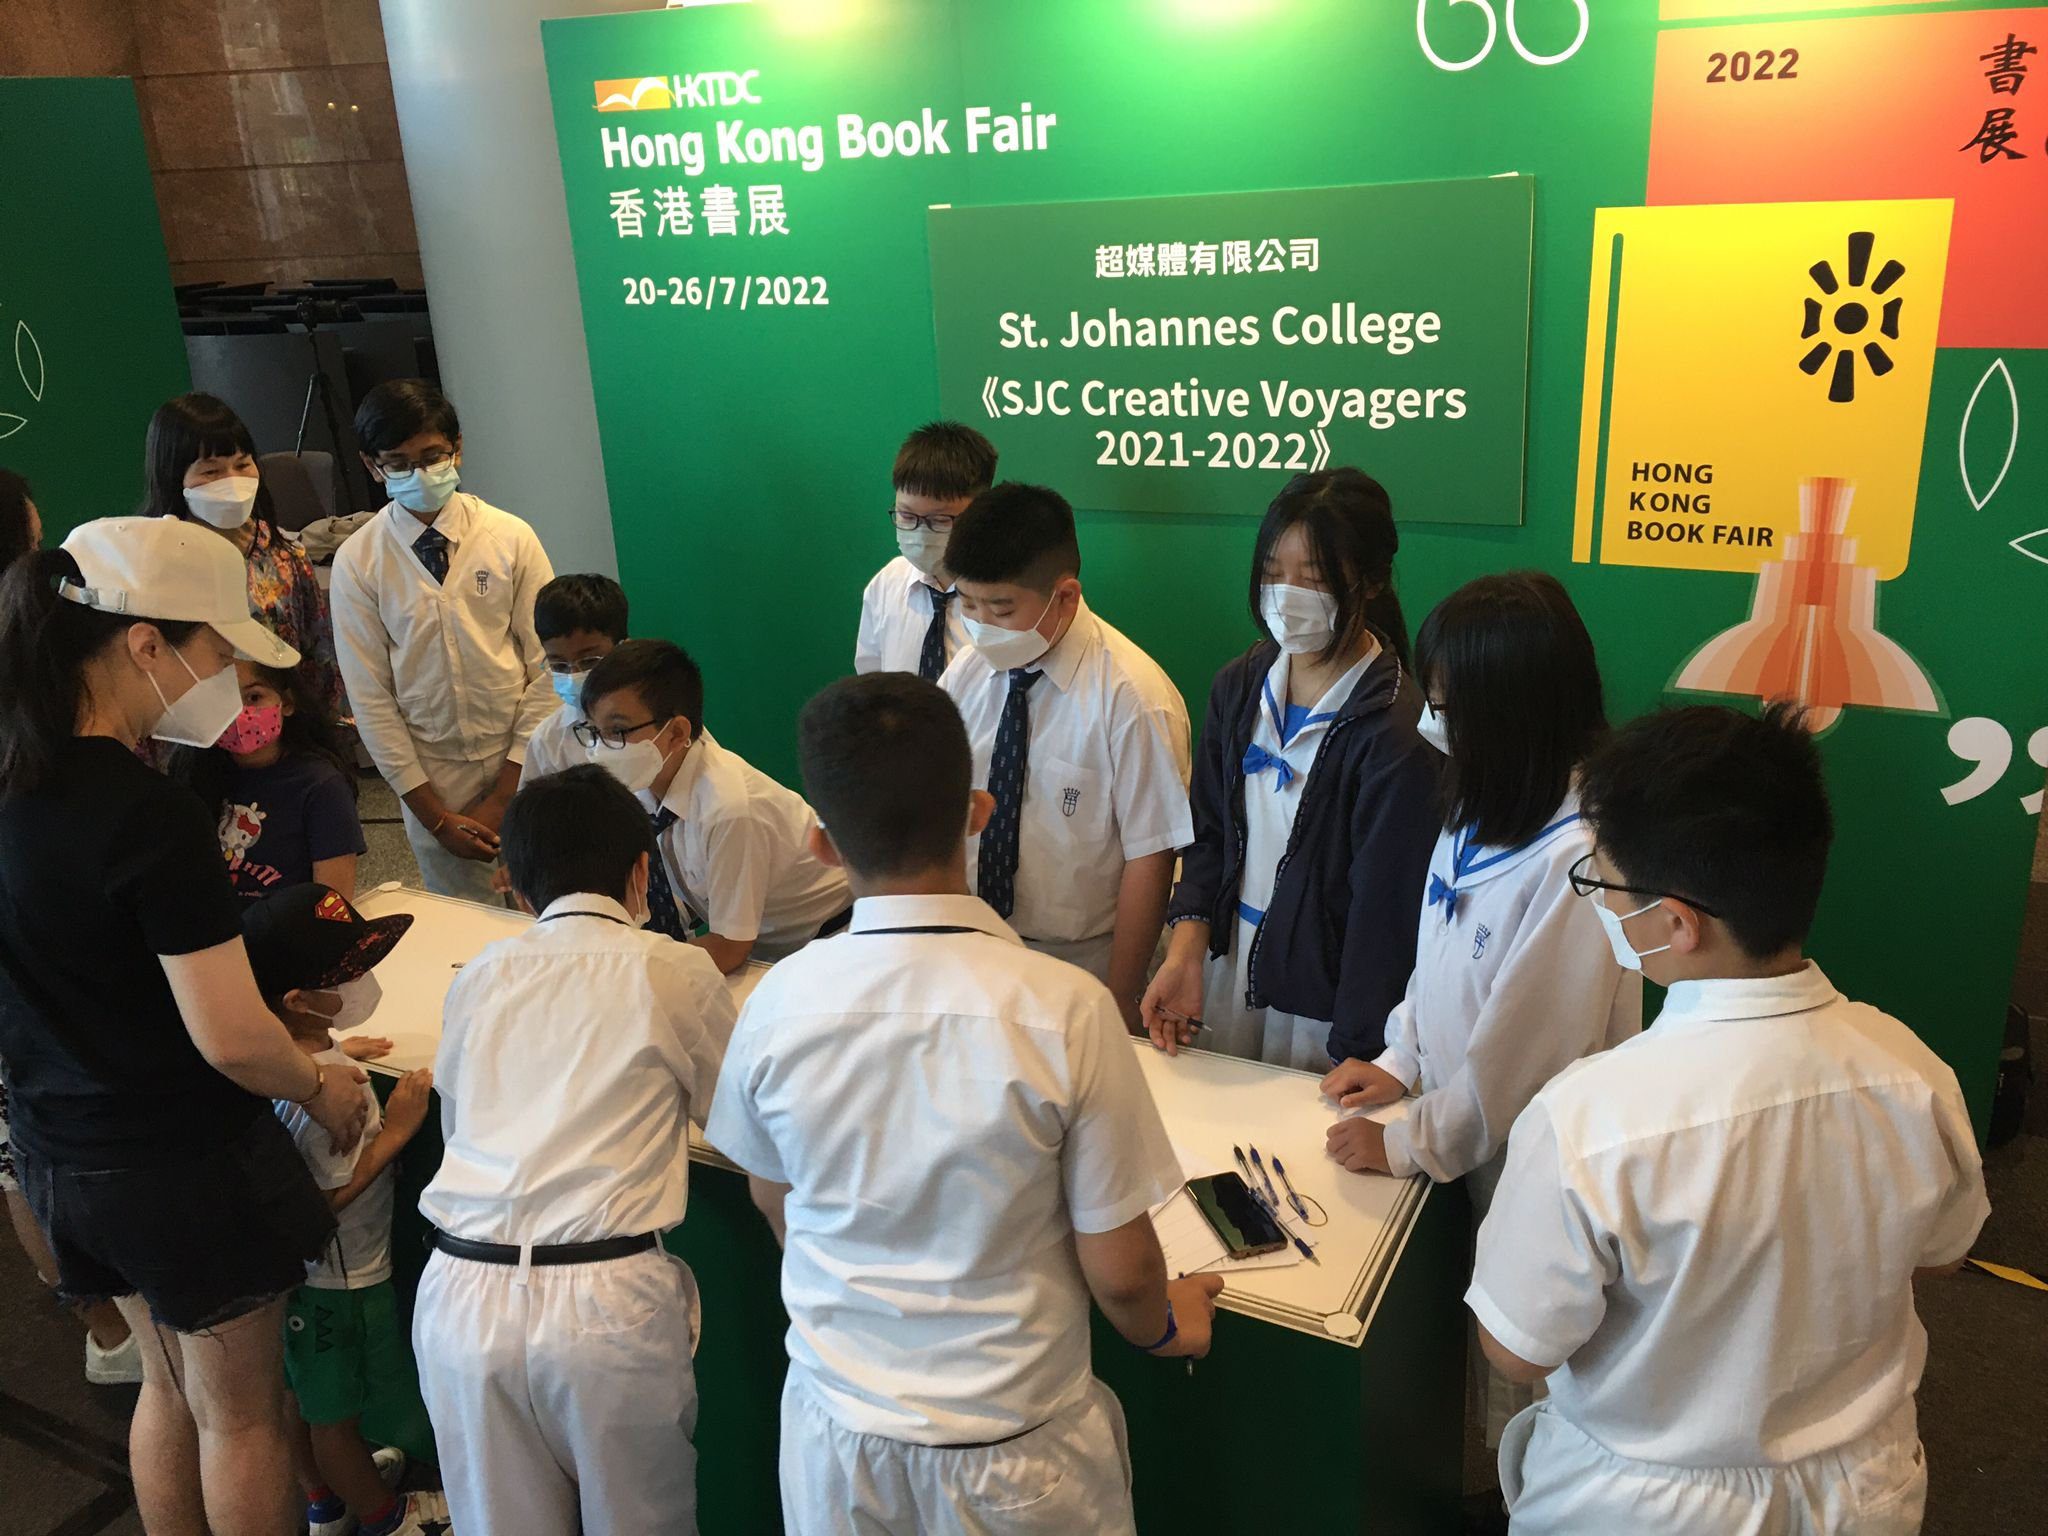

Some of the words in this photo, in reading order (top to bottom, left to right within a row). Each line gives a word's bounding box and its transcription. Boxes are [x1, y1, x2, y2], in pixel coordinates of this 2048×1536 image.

[1706, 48, 1800, 84] 2022
[673, 69, 762, 108] HKTDC
[1959, 33, 2038, 165] 書展
[600, 126, 706, 177] Hong
[715, 119, 825, 172] Kong
[836, 107, 951, 159] Book
[965, 101, 1057, 153] Fair
[609, 183, 790, 238] 香港書展
[1095, 238, 1319, 278] 超媒體有限公司
[622, 275, 830, 311] 20-26/7/2022
[999, 312, 1049, 349] St.
[1059, 307, 1260, 348] Johannes
[1271, 302, 1441, 355] College
[1081, 377, 1250, 418] Creative
[1259, 380, 1467, 430] Voyagers
[1631, 462, 1713, 485] HONG
[1629, 491, 1711, 515] KONG
[1627, 520, 1705, 544] BOOK
[1712, 524, 1774, 548] FAIR
